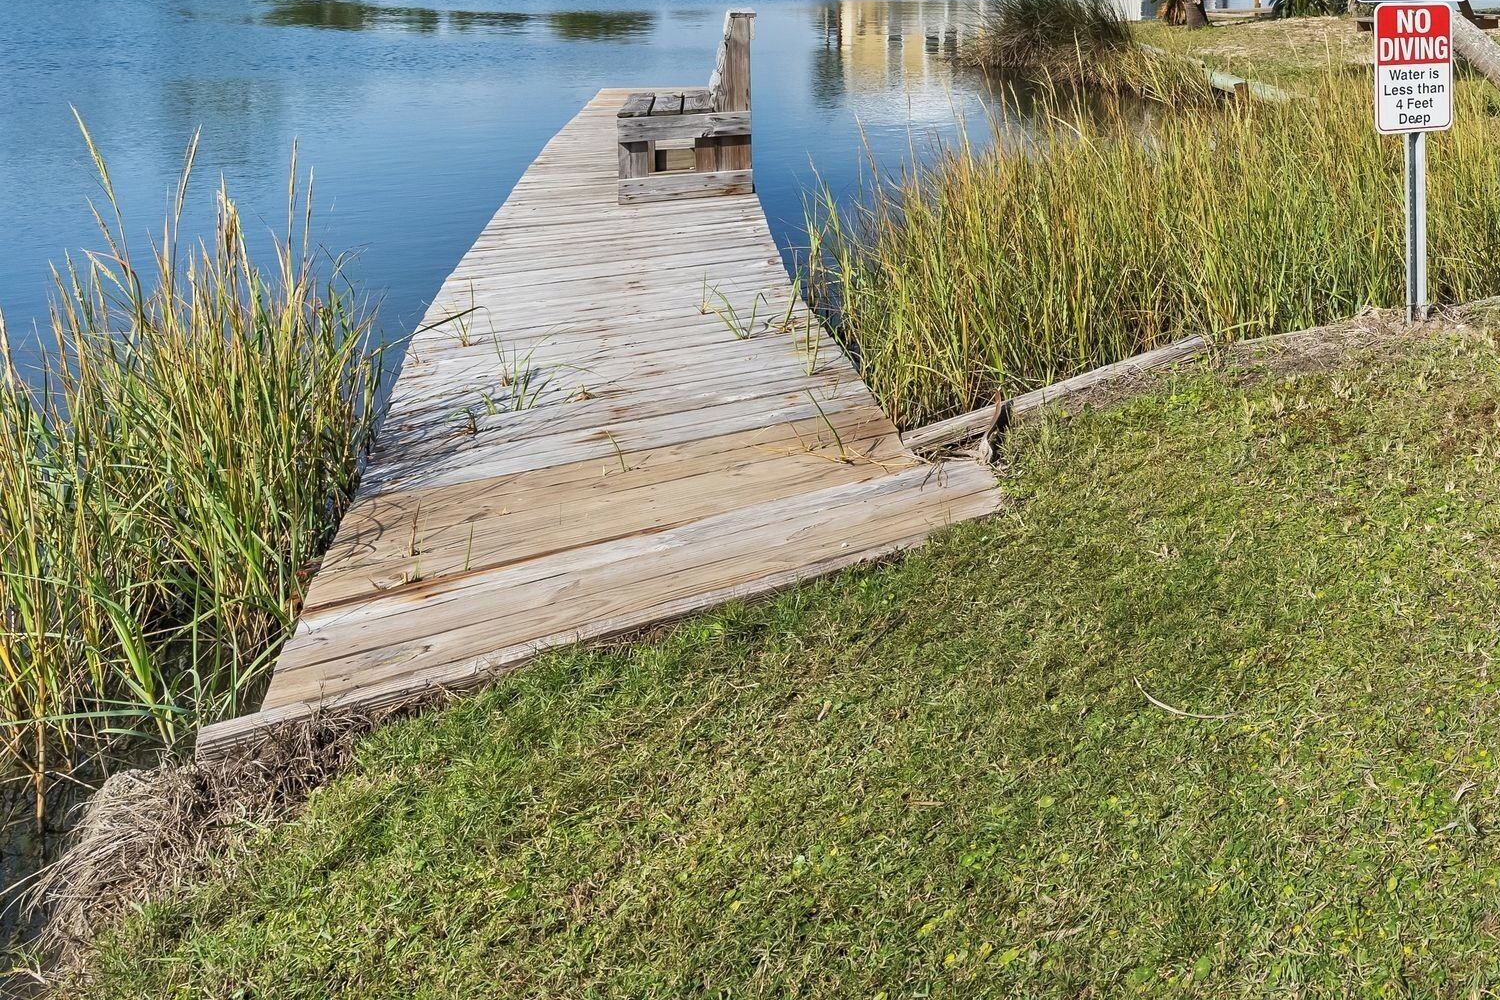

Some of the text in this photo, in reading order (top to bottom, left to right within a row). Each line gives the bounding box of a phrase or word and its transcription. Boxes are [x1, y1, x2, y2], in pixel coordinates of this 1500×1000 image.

[1396, 8, 1431, 34] NO
[1380, 36, 1448, 61] DIVING
[1389, 68, 1439, 80] Water is
[1384, 83, 1445, 96] Less than
[1396, 98, 1433, 109] 4 Feet
[1399, 113, 1431, 125] Deep
